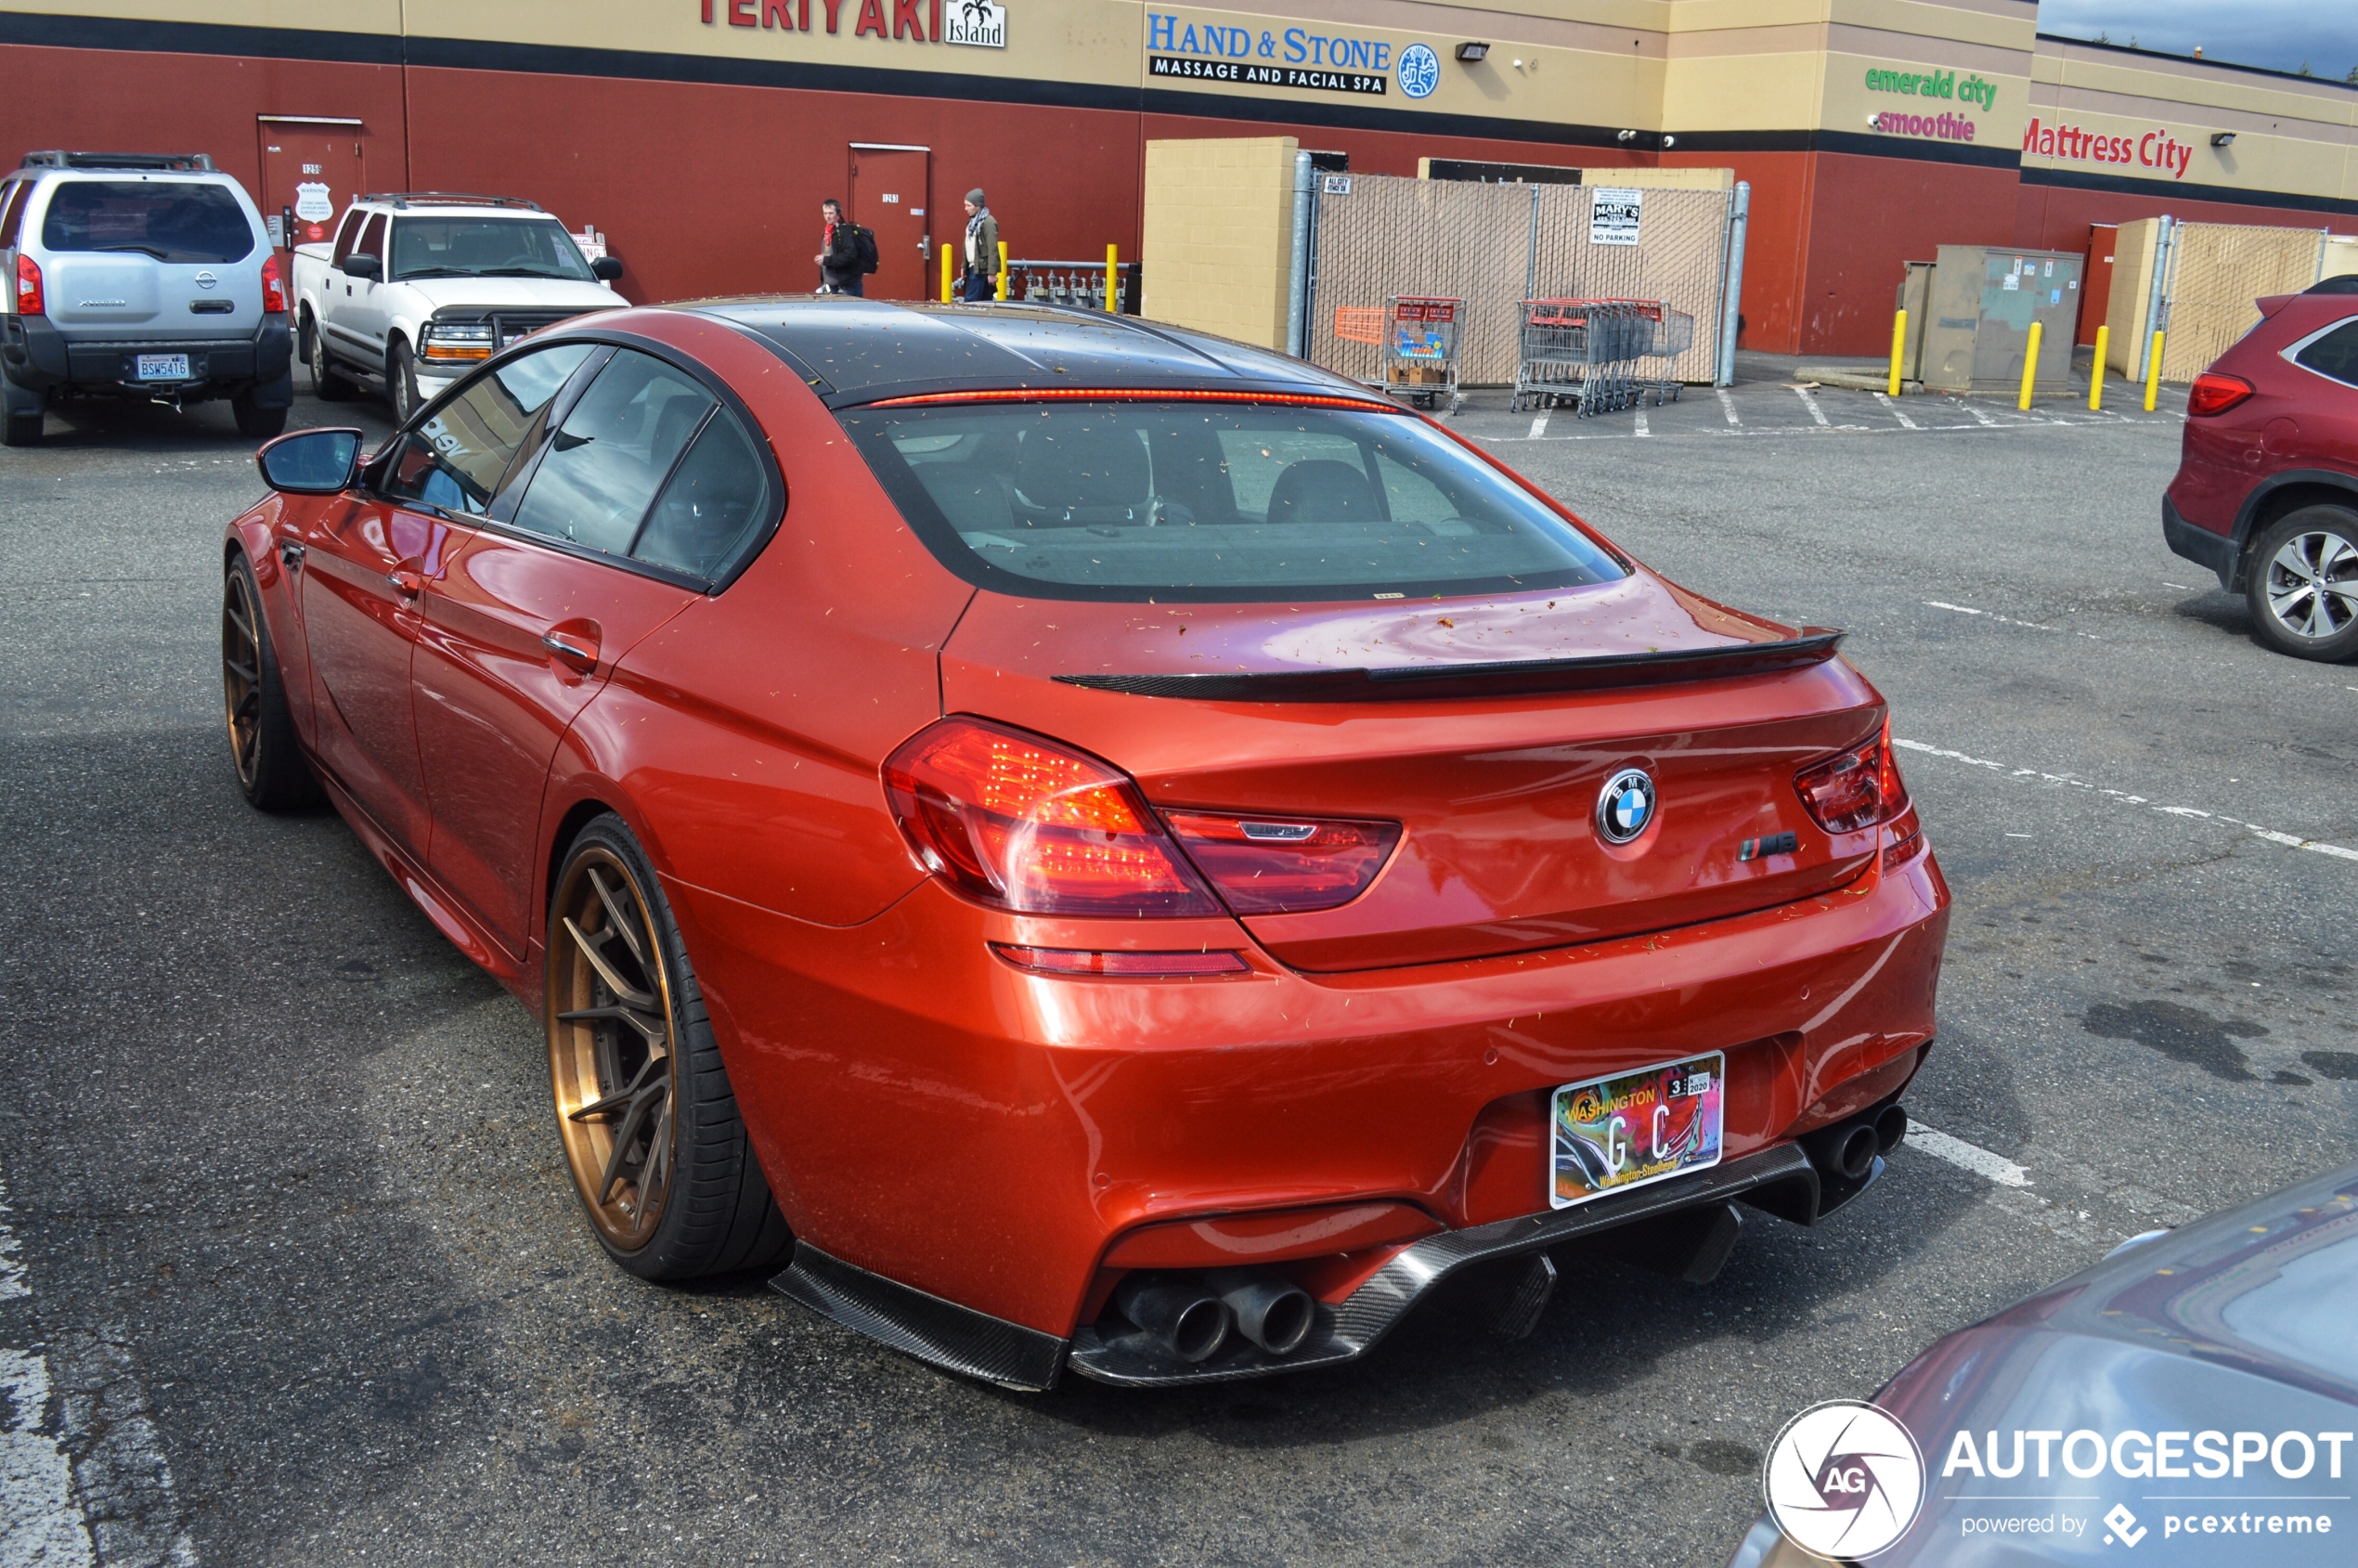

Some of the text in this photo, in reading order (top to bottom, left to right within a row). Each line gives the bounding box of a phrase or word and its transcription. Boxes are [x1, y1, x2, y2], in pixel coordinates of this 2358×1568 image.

[949, 19, 1002, 44] Island
[1147, 13, 1392, 71] HAND & STONE
[1155, 58, 1382, 92] MASSAGE AND FACIAL SPA
[1866, 69, 1997, 110] emerald city
[1878, 111, 1976, 141] smoothie
[2139, 129, 2194, 180] City
[1596, 204, 1639, 217] MARY'S
[141, 362, 186, 375] BSW5416
[1612, 777, 1652, 799] BMW
[1671, 1080, 1681, 1095] 3
[1690, 1082, 1708, 1093] 2020
[1566, 1089, 1655, 1123] WASHINGTON
[1609, 1105, 1669, 1171] G C
